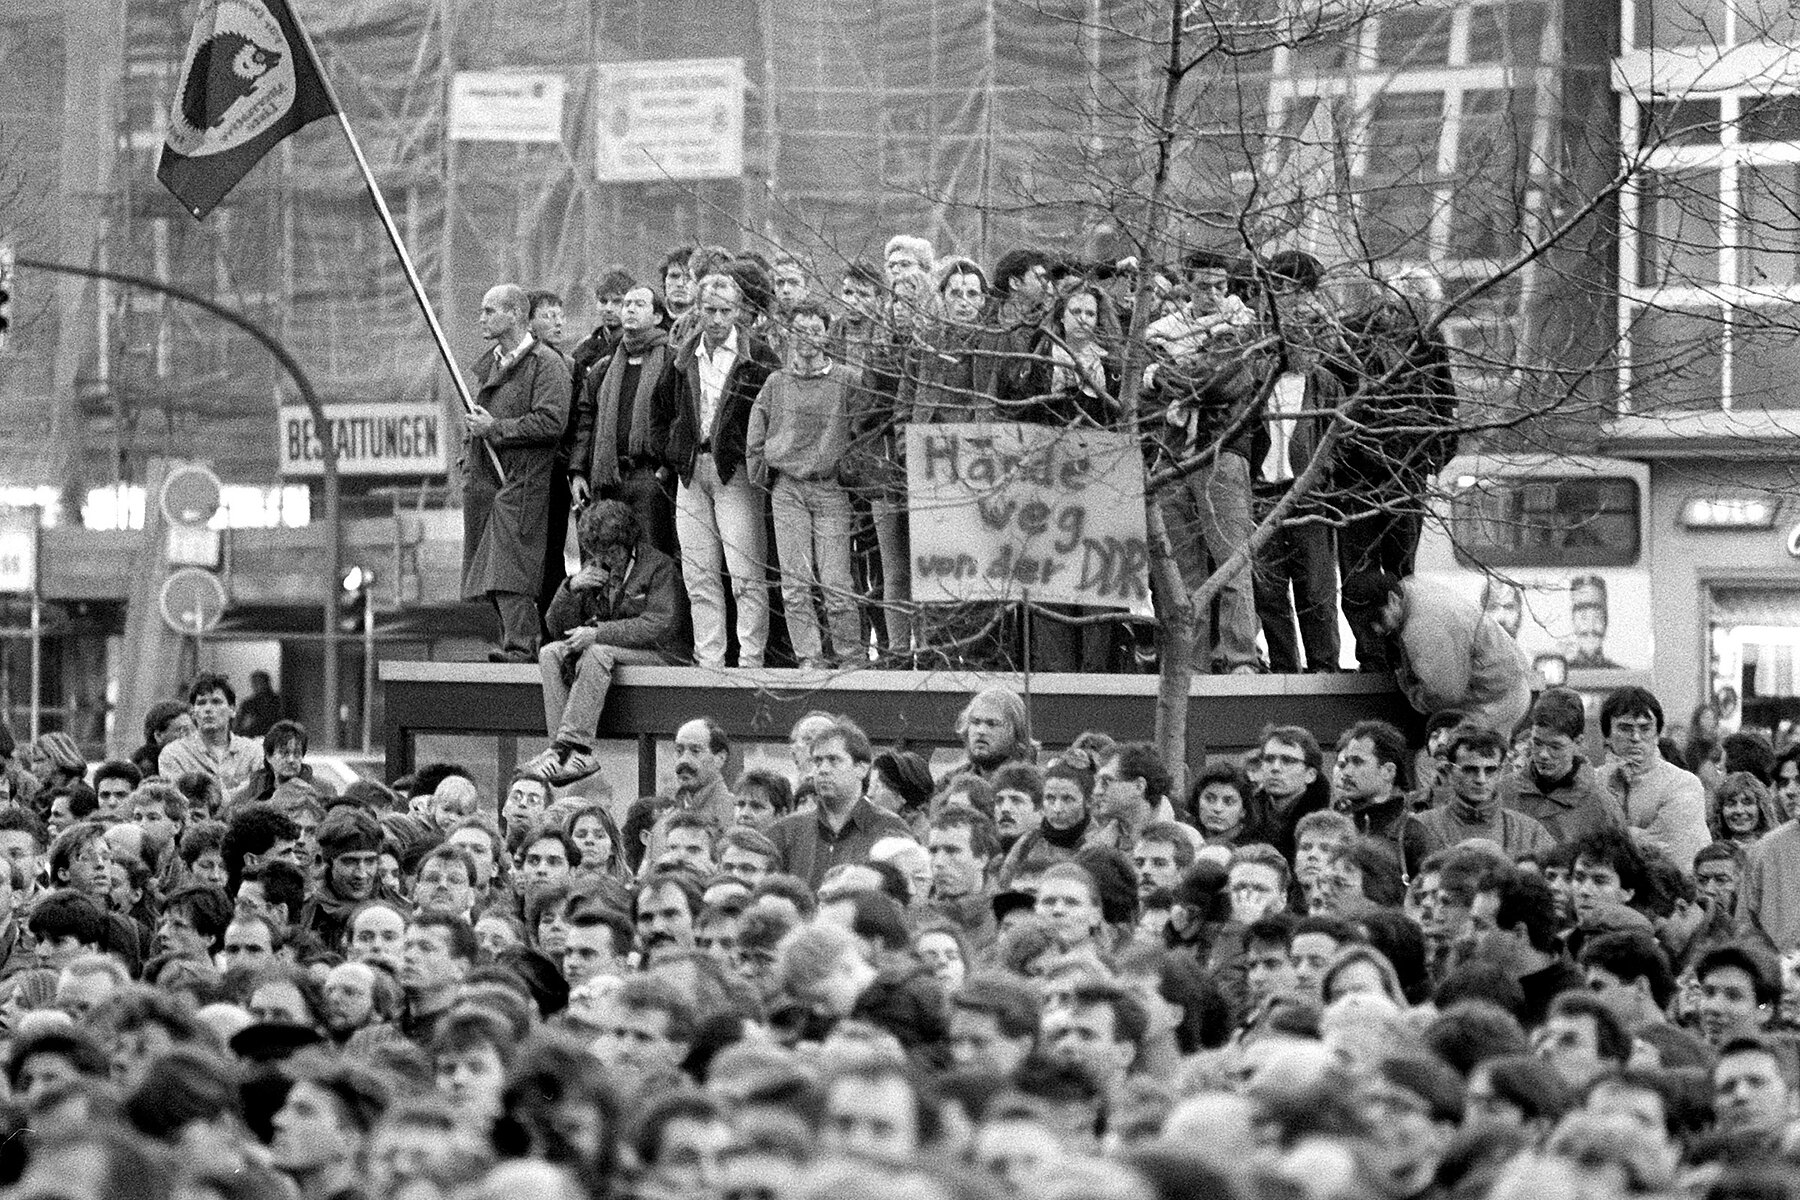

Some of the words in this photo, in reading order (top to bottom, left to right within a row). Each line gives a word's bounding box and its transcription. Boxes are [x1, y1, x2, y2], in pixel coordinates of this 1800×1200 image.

[289, 416, 437, 461] BEATTUNGEN
[917, 554, 977, 579] von
[988, 544, 1064, 584] der
[1076, 535, 1147, 600] DDR
